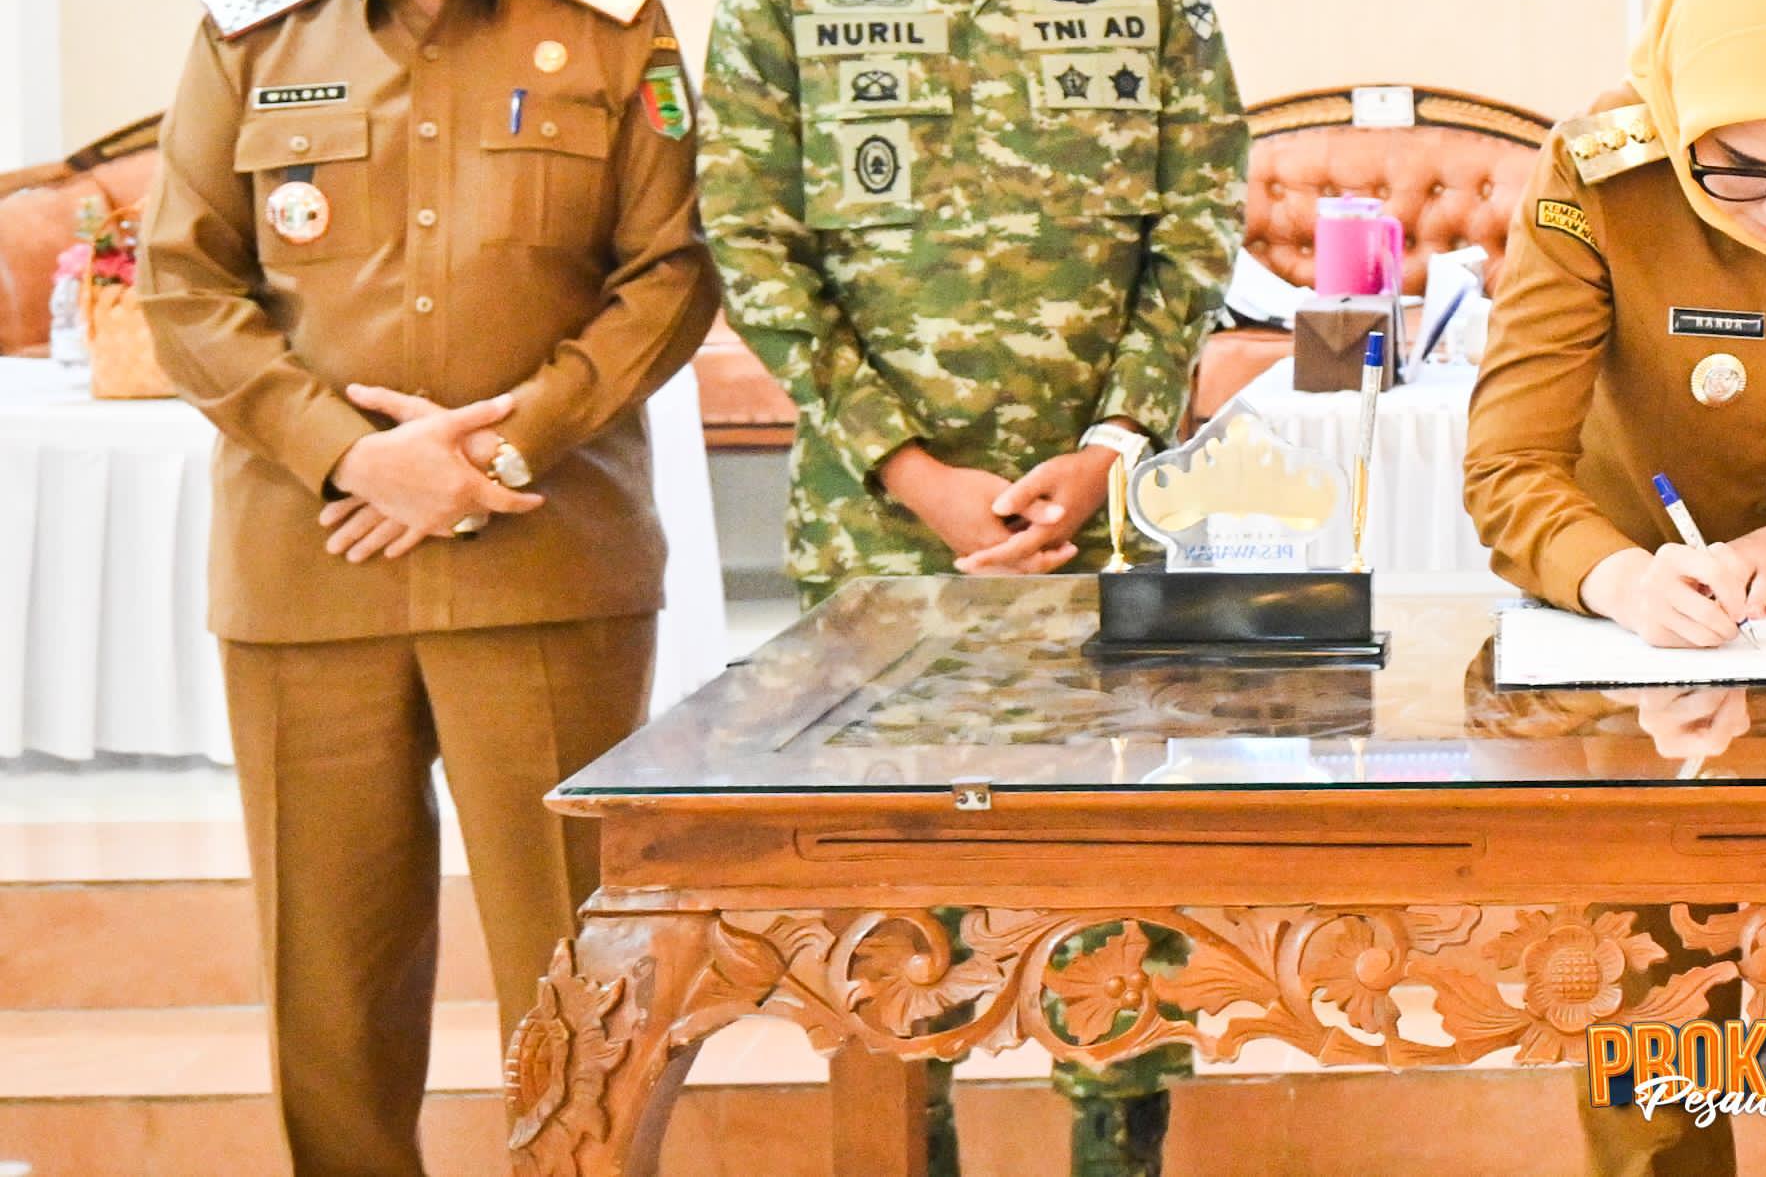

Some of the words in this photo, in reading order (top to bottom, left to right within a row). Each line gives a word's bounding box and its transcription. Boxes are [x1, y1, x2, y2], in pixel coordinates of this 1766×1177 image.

[816, 21, 925, 47] NURIL
[1033, 18, 1087, 42] TNI
[1103, 15, 1146, 39] AD
